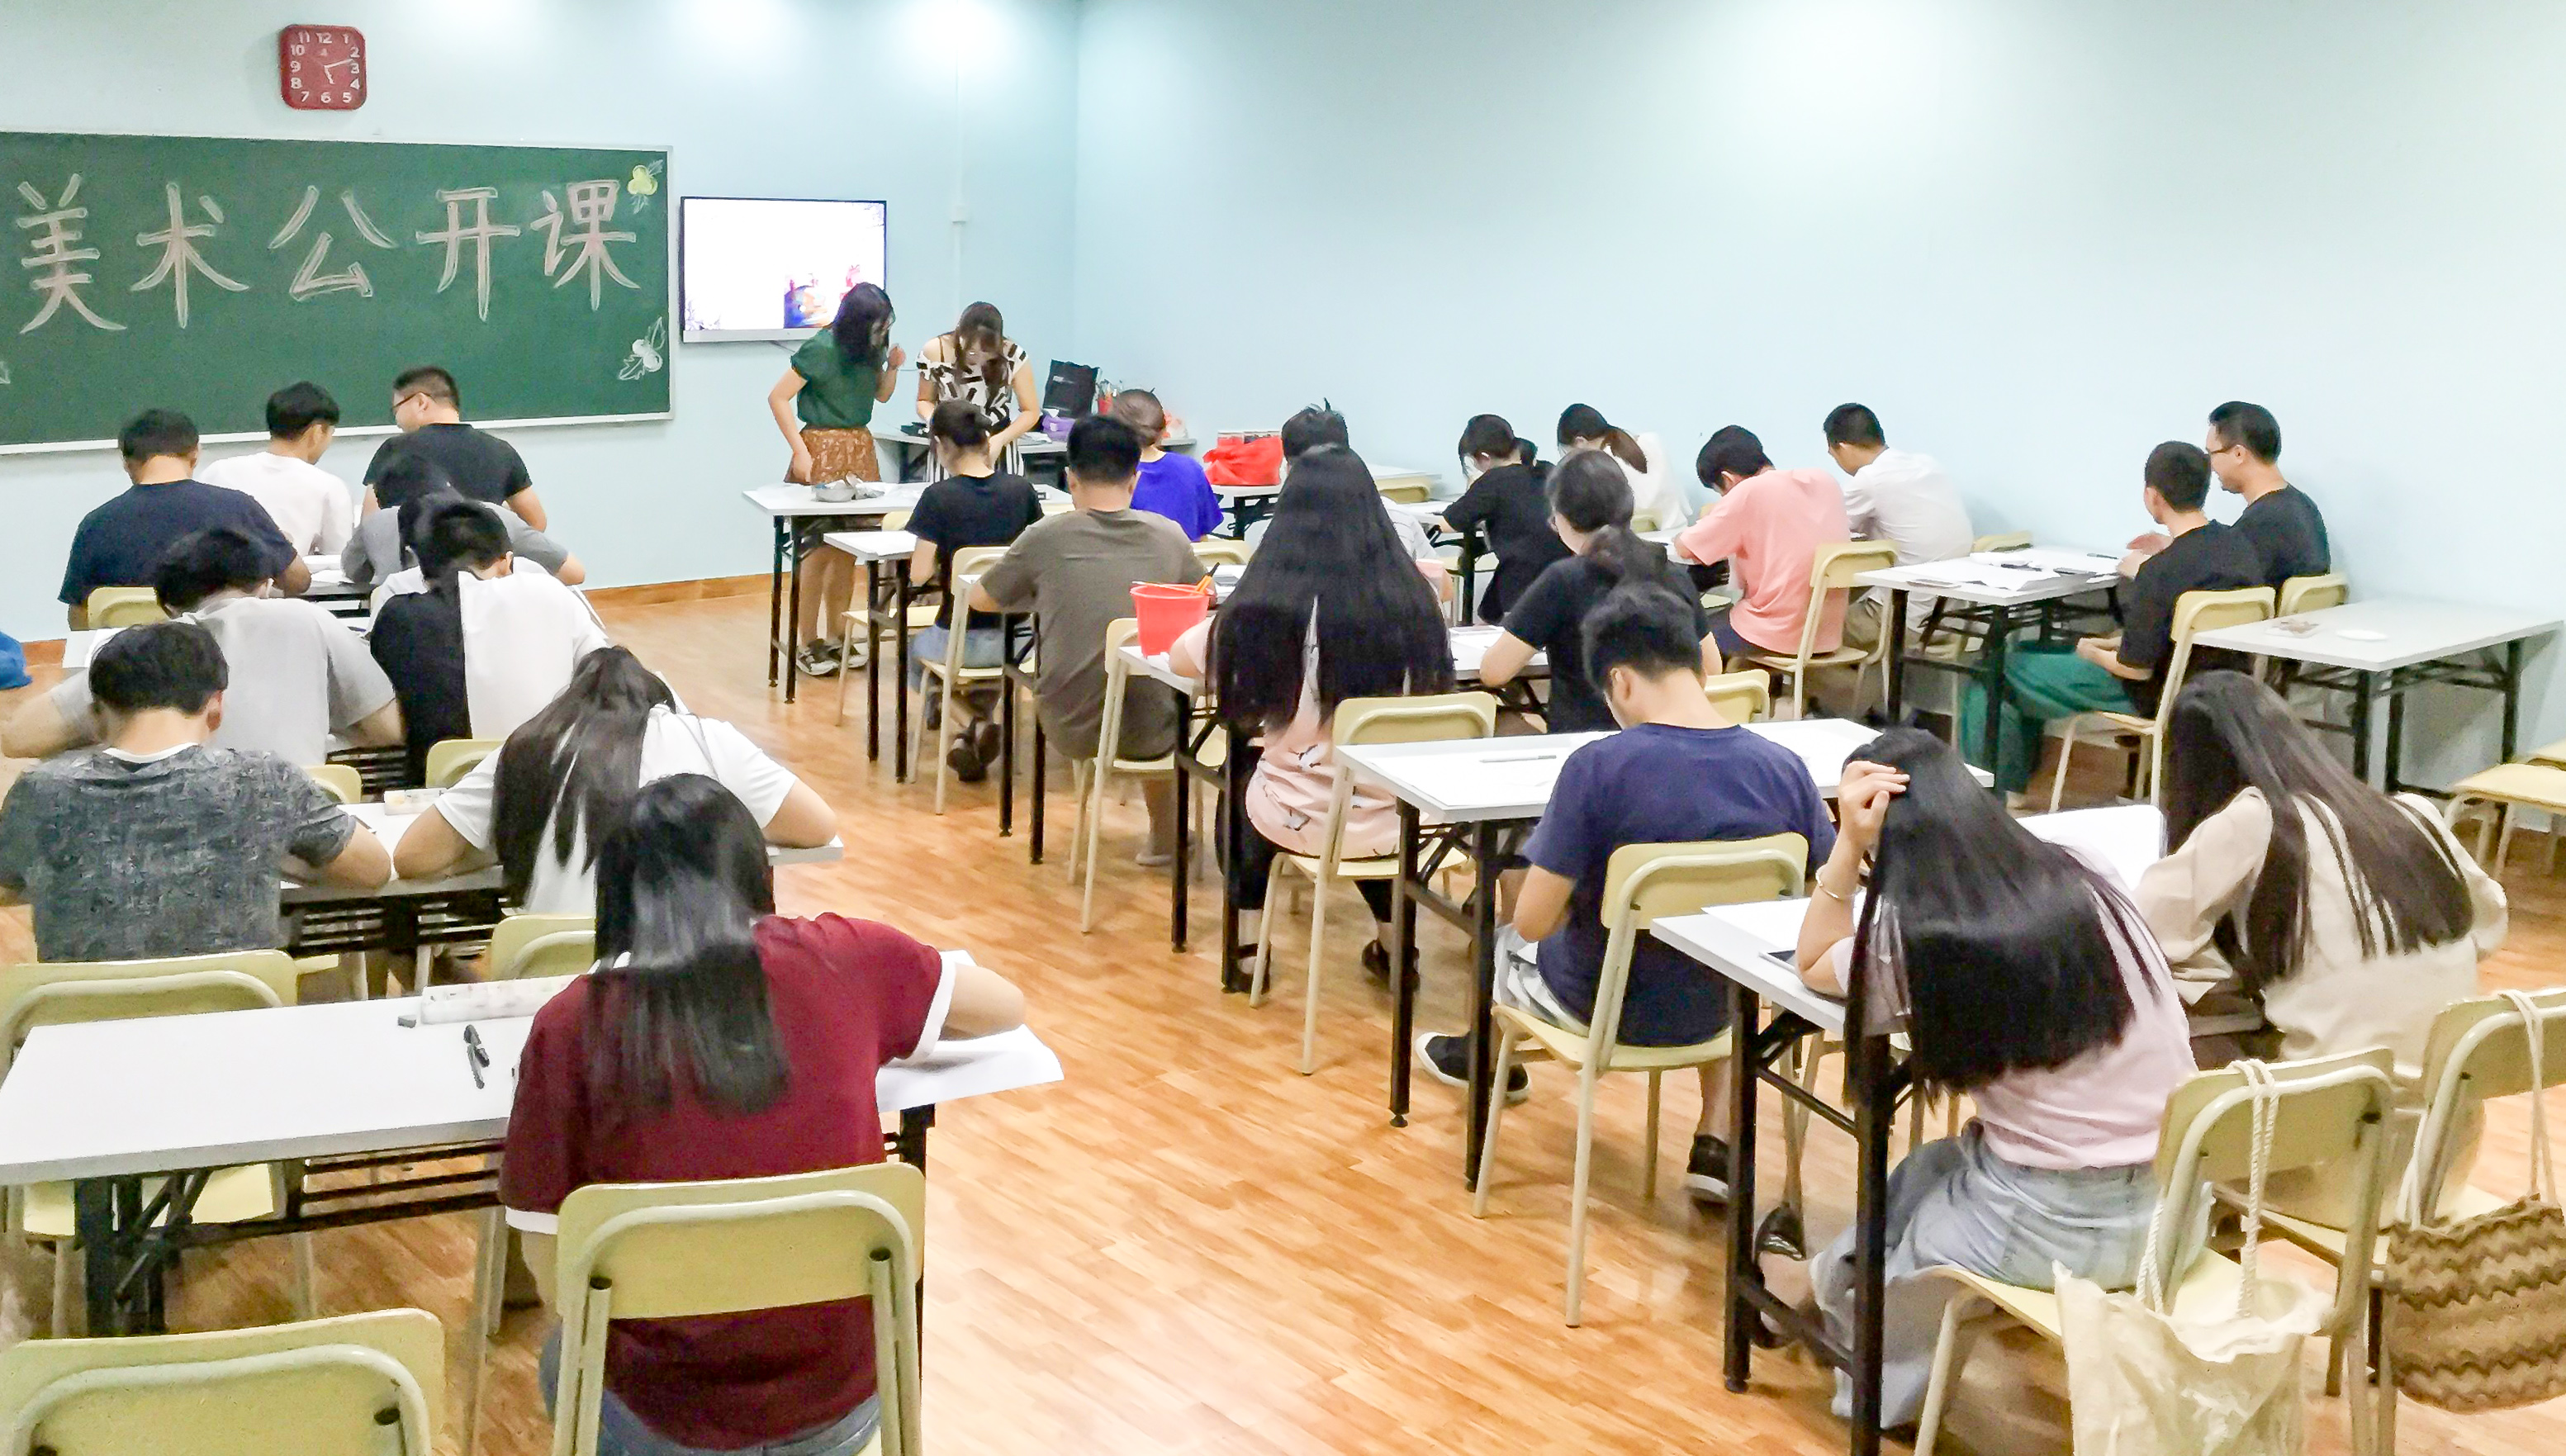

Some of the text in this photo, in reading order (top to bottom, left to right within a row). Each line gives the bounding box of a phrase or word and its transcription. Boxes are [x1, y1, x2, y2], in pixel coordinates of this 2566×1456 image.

[298, 31, 311, 44] 11
[315, 33, 333, 44] 12
[343, 33, 349, 44] 1
[290, 44, 306, 56] 10
[350, 46, 360, 58] 2
[290, 60, 301, 73] 9
[350, 62, 360, 74] 3
[290, 77, 302, 89] 8
[349, 78, 360, 90] 4
[301, 91, 310, 102] 7
[320, 92, 332, 103] 6
[342, 92, 353, 103] 5
[17, 173, 641, 334] 美术公开课
